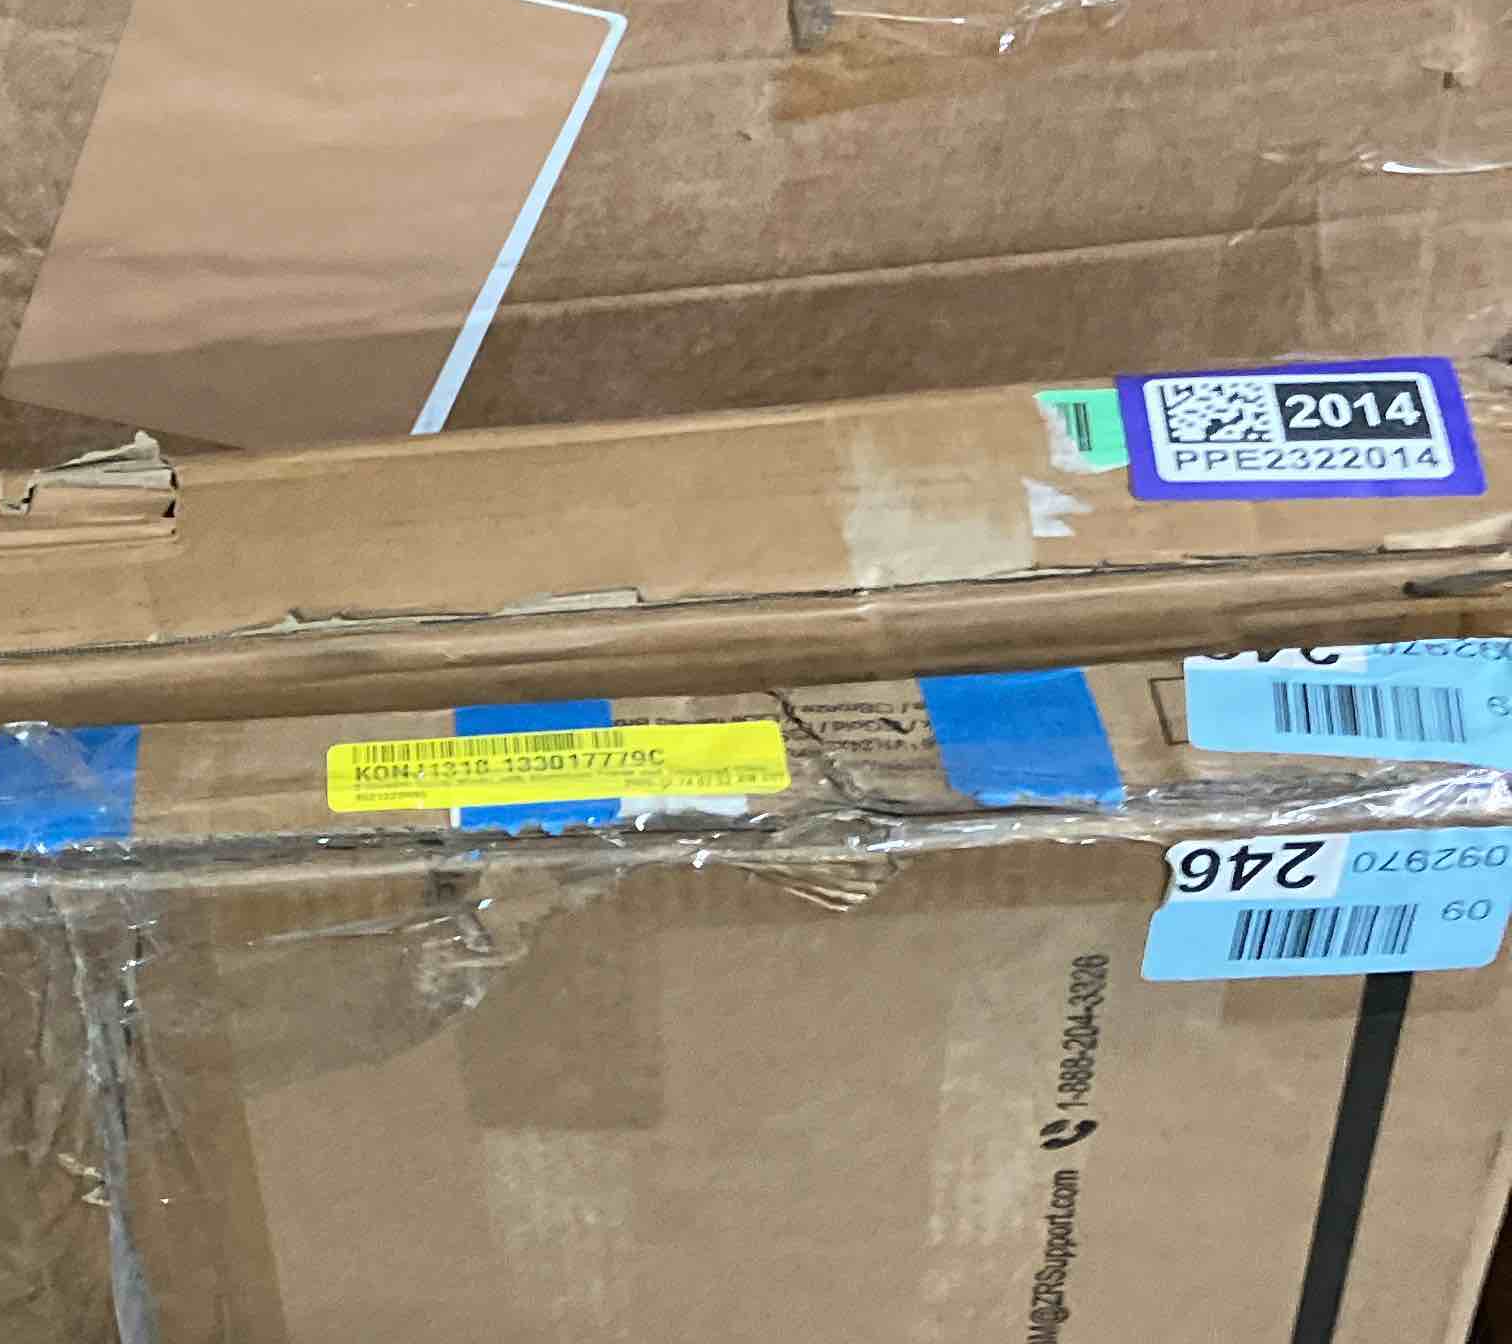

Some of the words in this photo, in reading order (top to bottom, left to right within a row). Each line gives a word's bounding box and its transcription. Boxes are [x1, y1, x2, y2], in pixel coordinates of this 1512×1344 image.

[1285, 391, 1422, 430] 2014
[1174, 445, 1441, 472] PPE2322014
[1178, 840, 1327, 893] 246
[1352, 844, 1510, 874] 092970
[1440, 898, 1493, 922] 09
